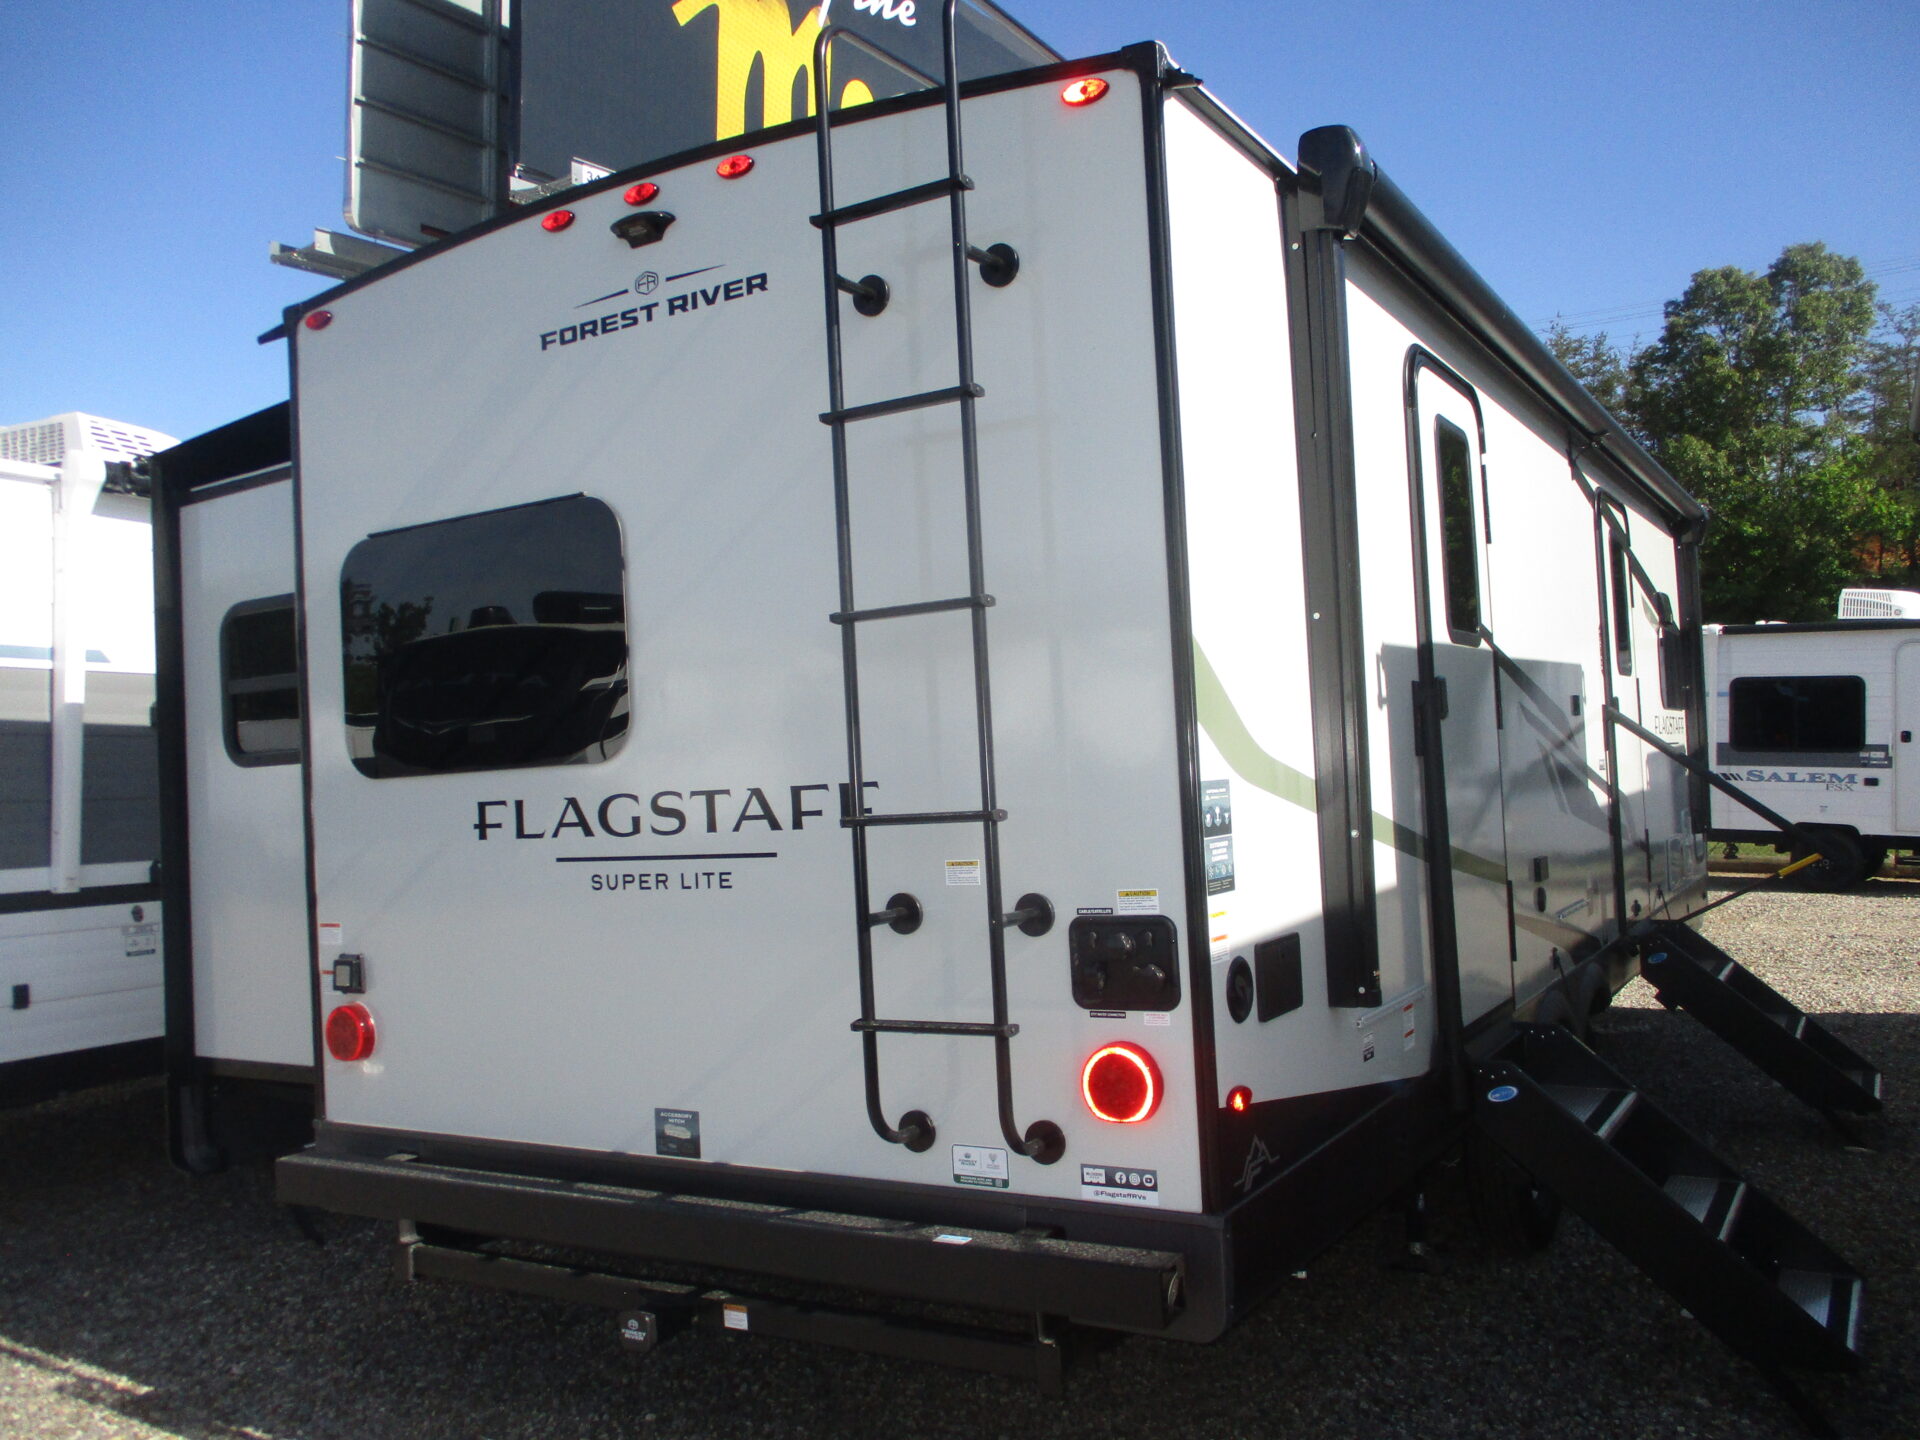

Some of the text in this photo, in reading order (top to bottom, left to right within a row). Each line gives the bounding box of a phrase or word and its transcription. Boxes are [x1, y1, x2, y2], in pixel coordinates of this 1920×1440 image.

[539, 272, 769, 351] FOREST RIVER
[1745, 769, 1859, 785] SALEM
[473, 781, 880, 841] FLAGSTAFF
[591, 871, 734, 892] SUPER LITE
[1093, 1189, 1147, 1201] @FlagstaffRVs
